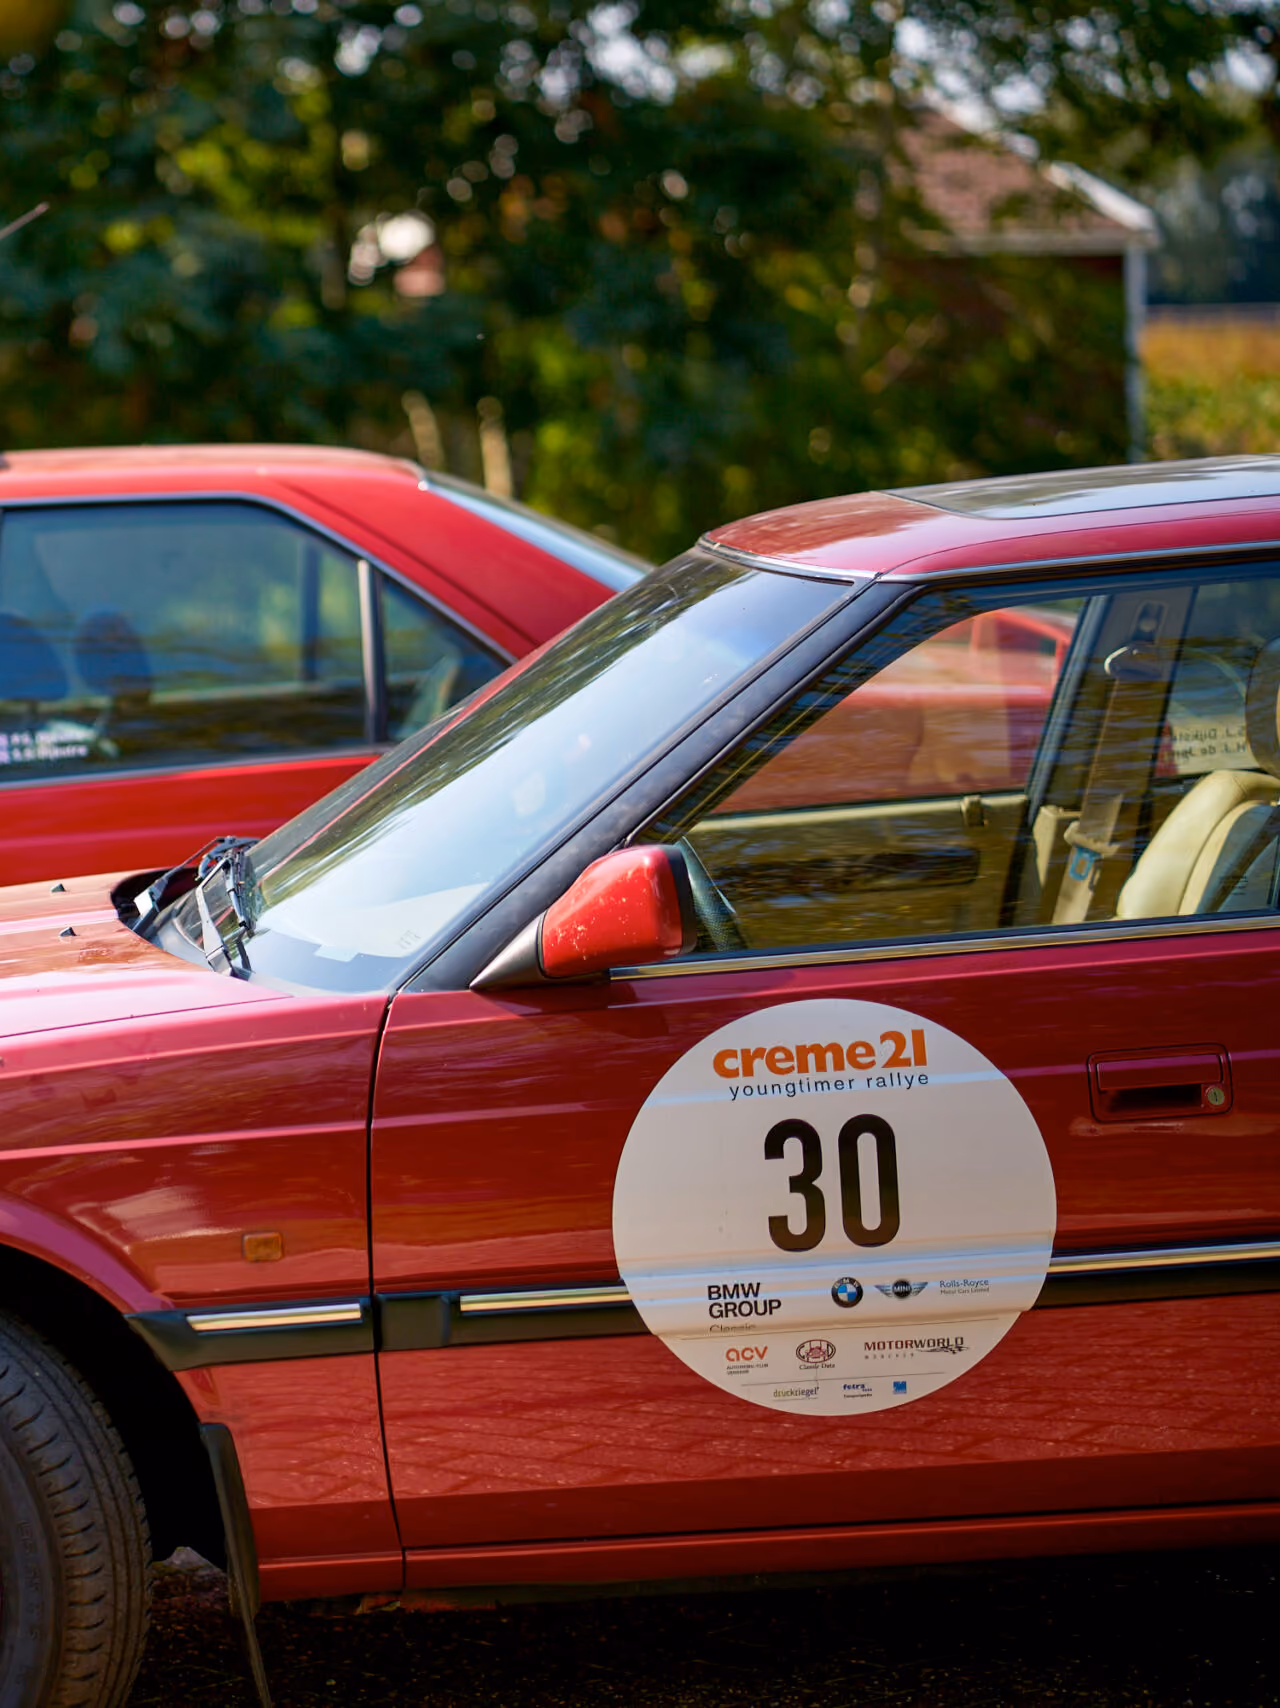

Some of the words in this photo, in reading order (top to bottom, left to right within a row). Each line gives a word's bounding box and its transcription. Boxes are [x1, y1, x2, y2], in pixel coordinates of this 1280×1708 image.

[713, 1029, 927, 1079] creme21
[729, 1077, 854, 1100] youngtimer
[866, 1072, 929, 1090] rallye
[764, 1113, 900, 1252] 30
[707, 1282, 761, 1301] BMW
[893, 1285, 912, 1293] MINI
[939, 1279, 989, 1288] Rolls-Royce
[708, 1299, 782, 1320] GROUP
[864, 1336, 964, 1350] MOTORWORLD
[725, 1345, 769, 1362] acv
